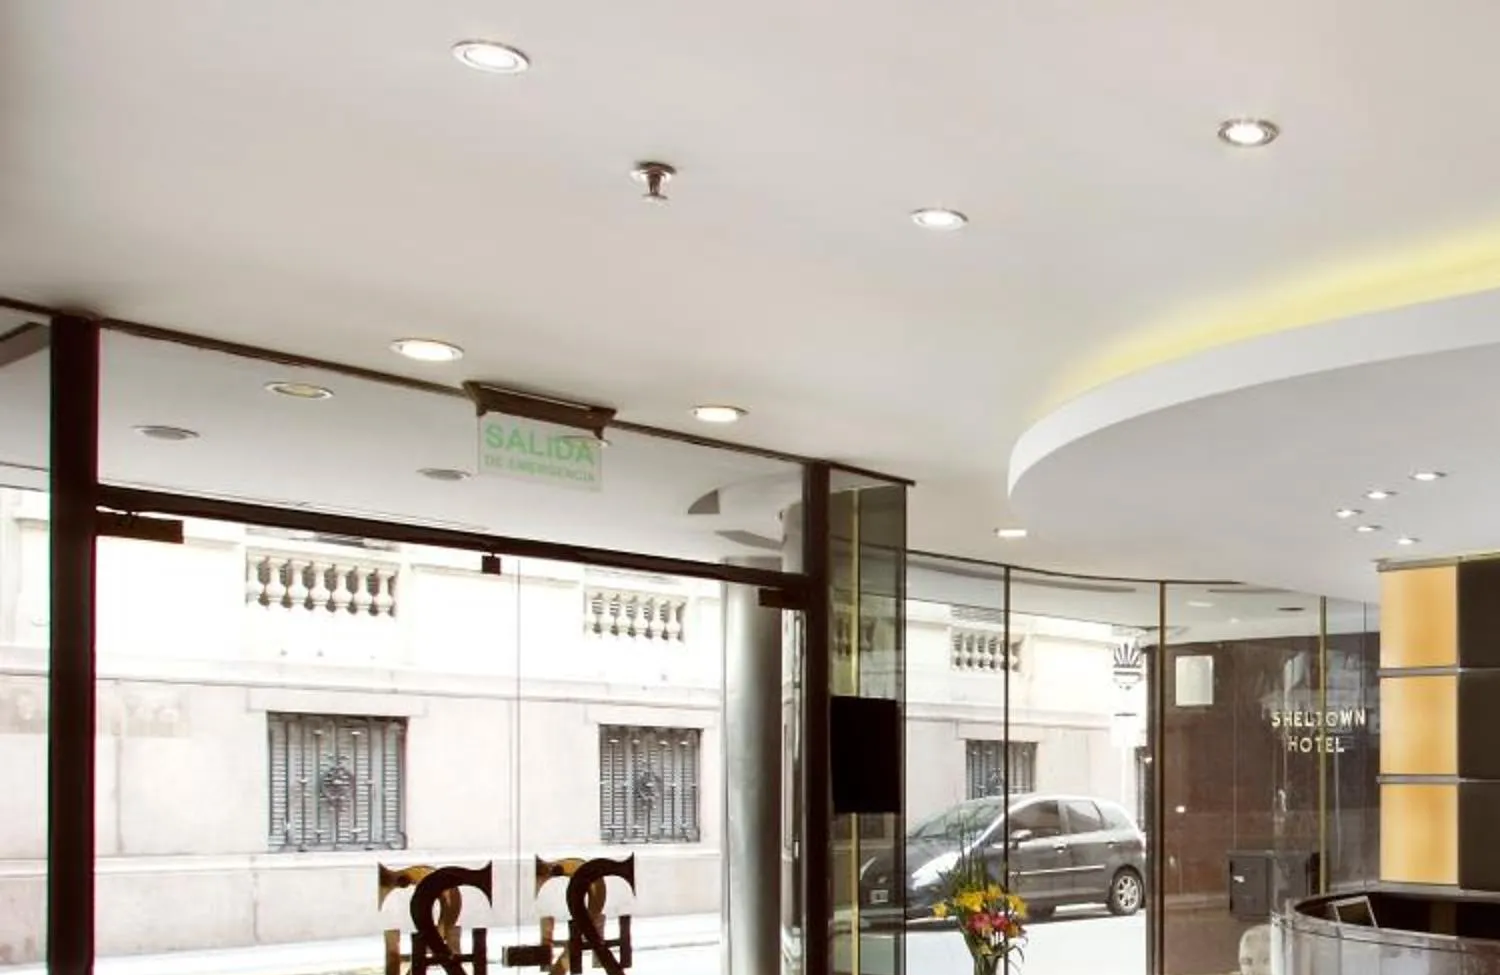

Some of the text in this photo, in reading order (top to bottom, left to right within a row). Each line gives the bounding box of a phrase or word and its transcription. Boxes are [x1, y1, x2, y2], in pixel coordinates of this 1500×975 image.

[484, 423, 595, 464] SALIDA
[1271, 707, 1366, 728] SHELTOWN
[1287, 736, 1345, 753] HOTEL
